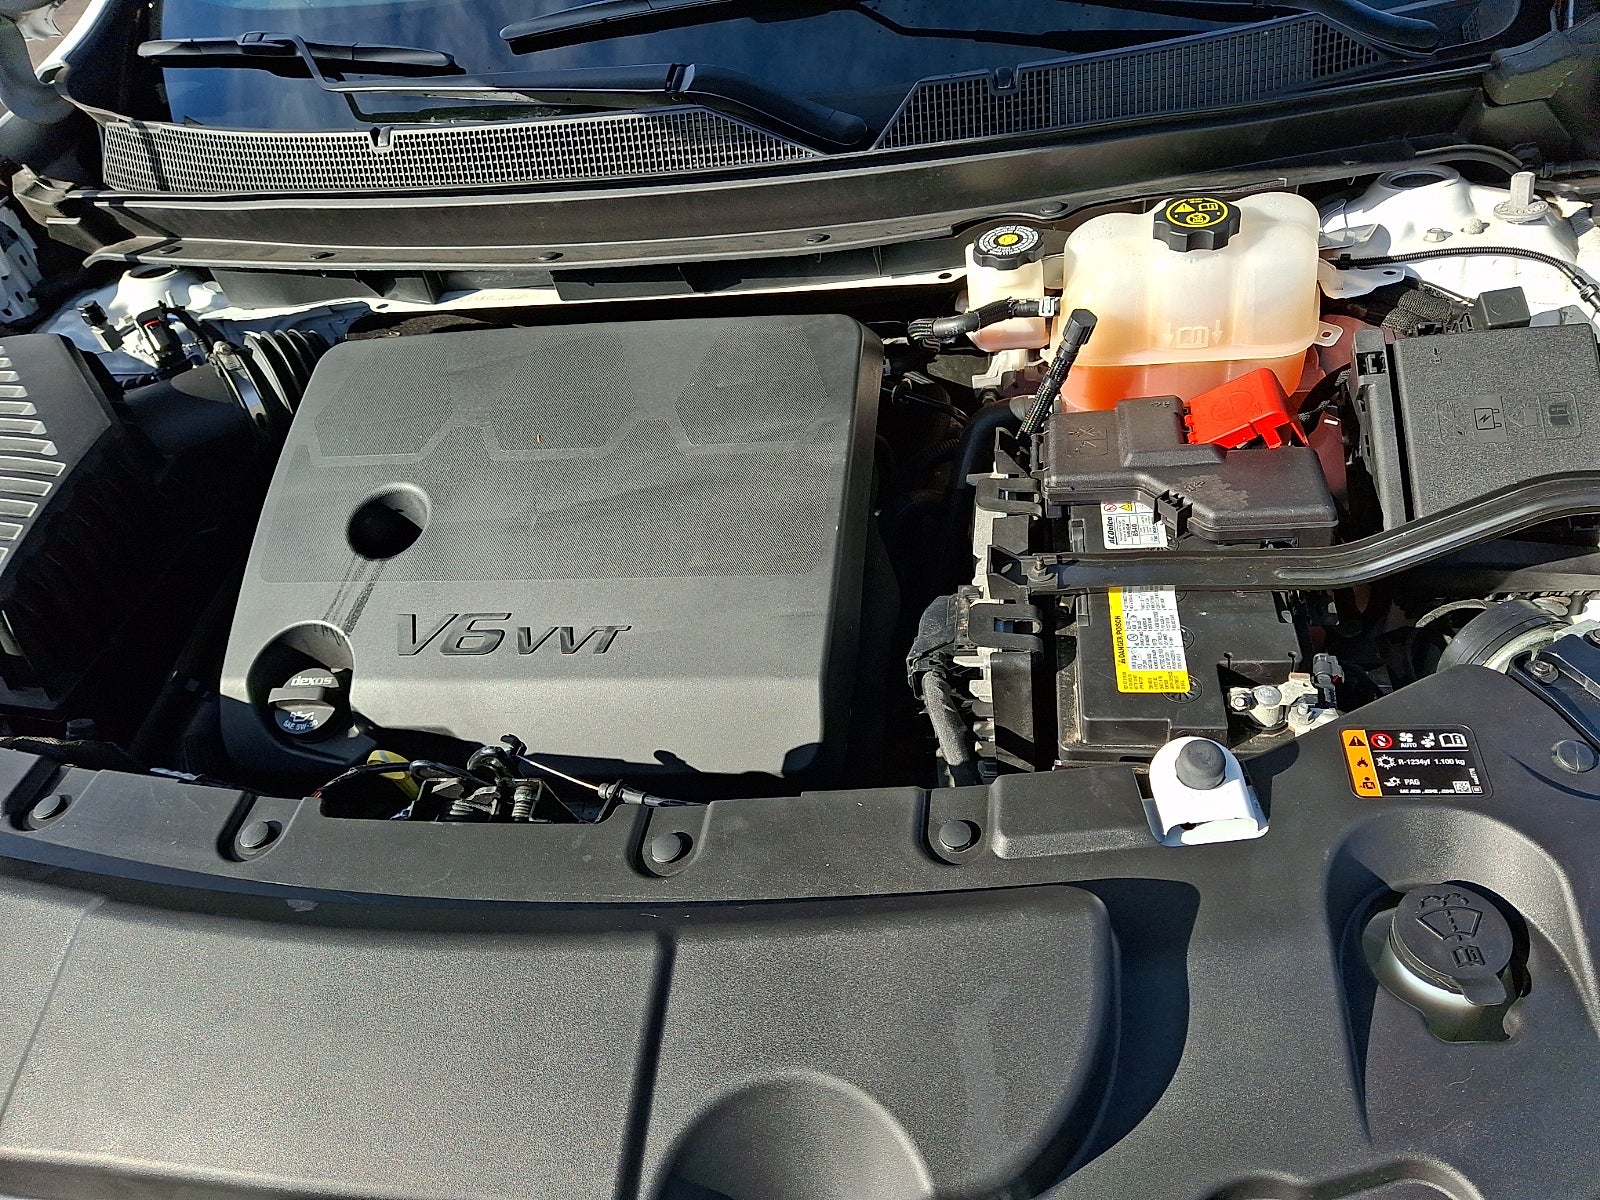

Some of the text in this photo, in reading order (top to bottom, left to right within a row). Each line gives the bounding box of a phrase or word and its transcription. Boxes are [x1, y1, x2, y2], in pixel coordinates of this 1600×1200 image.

[1106, 516, 1115, 545] ACDelco
[396, 612, 632, 656] V6 VVT
[290, 675, 333, 686] dexos
[283, 719, 319, 730] SAE 5W-30
[1455, 758, 1466, 766] kg
[1404, 778, 1421, 786] PAG
